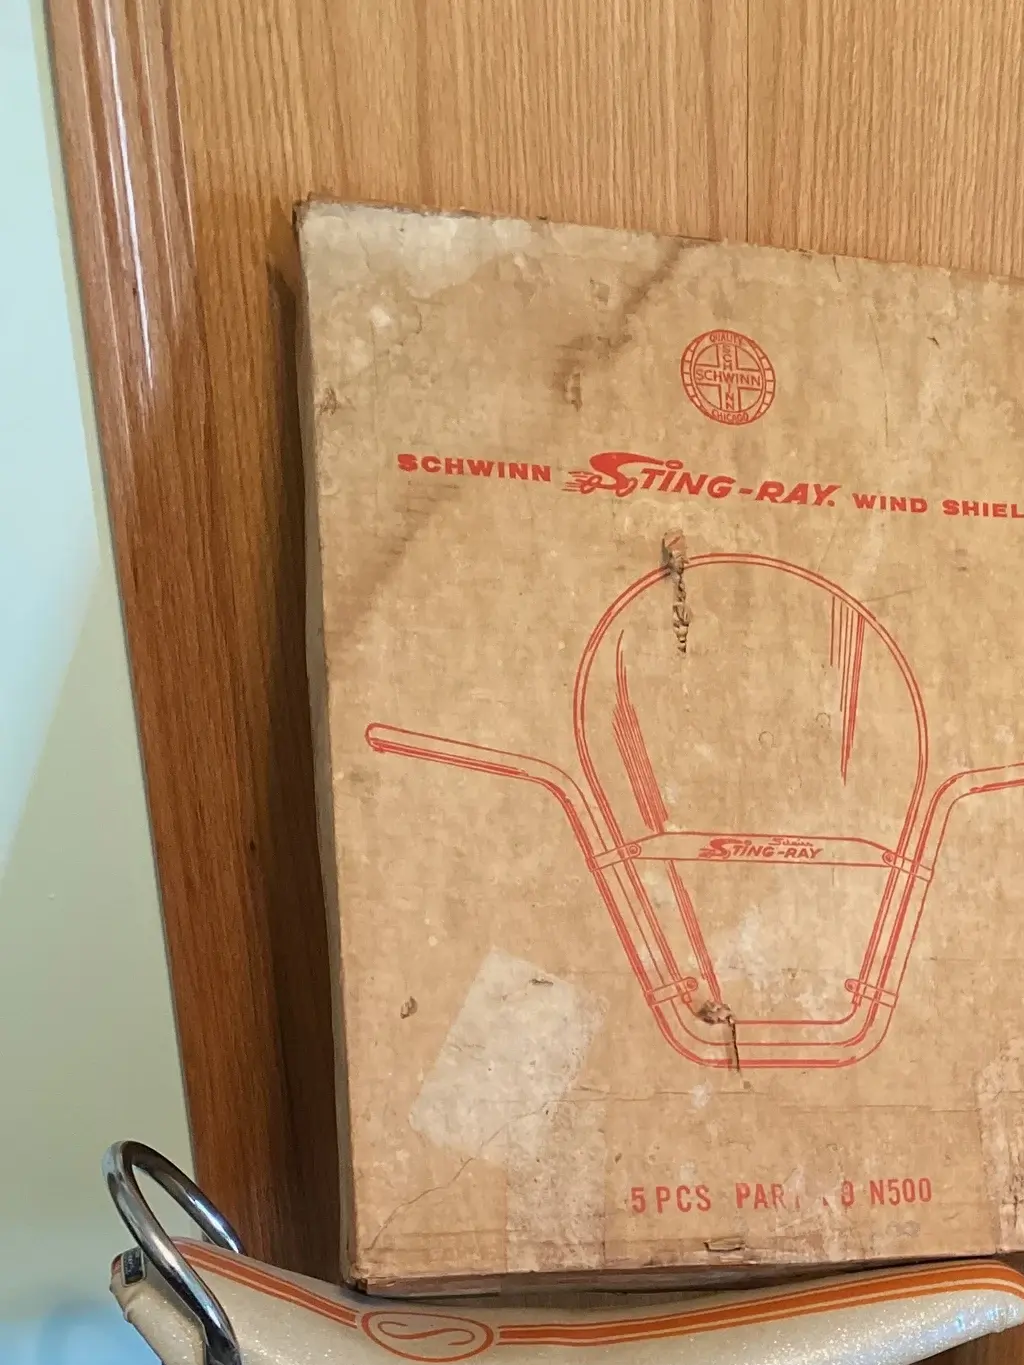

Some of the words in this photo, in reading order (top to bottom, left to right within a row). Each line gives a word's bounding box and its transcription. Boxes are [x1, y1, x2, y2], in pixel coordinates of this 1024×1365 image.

[695, 368, 761, 387] SCHWINN
[397, 453, 552, 482] SCHWINN
[851, 492, 928, 513] WIND
[735, 1182, 801, 1211] PAR
[869, 1177, 932, 1206] N500
